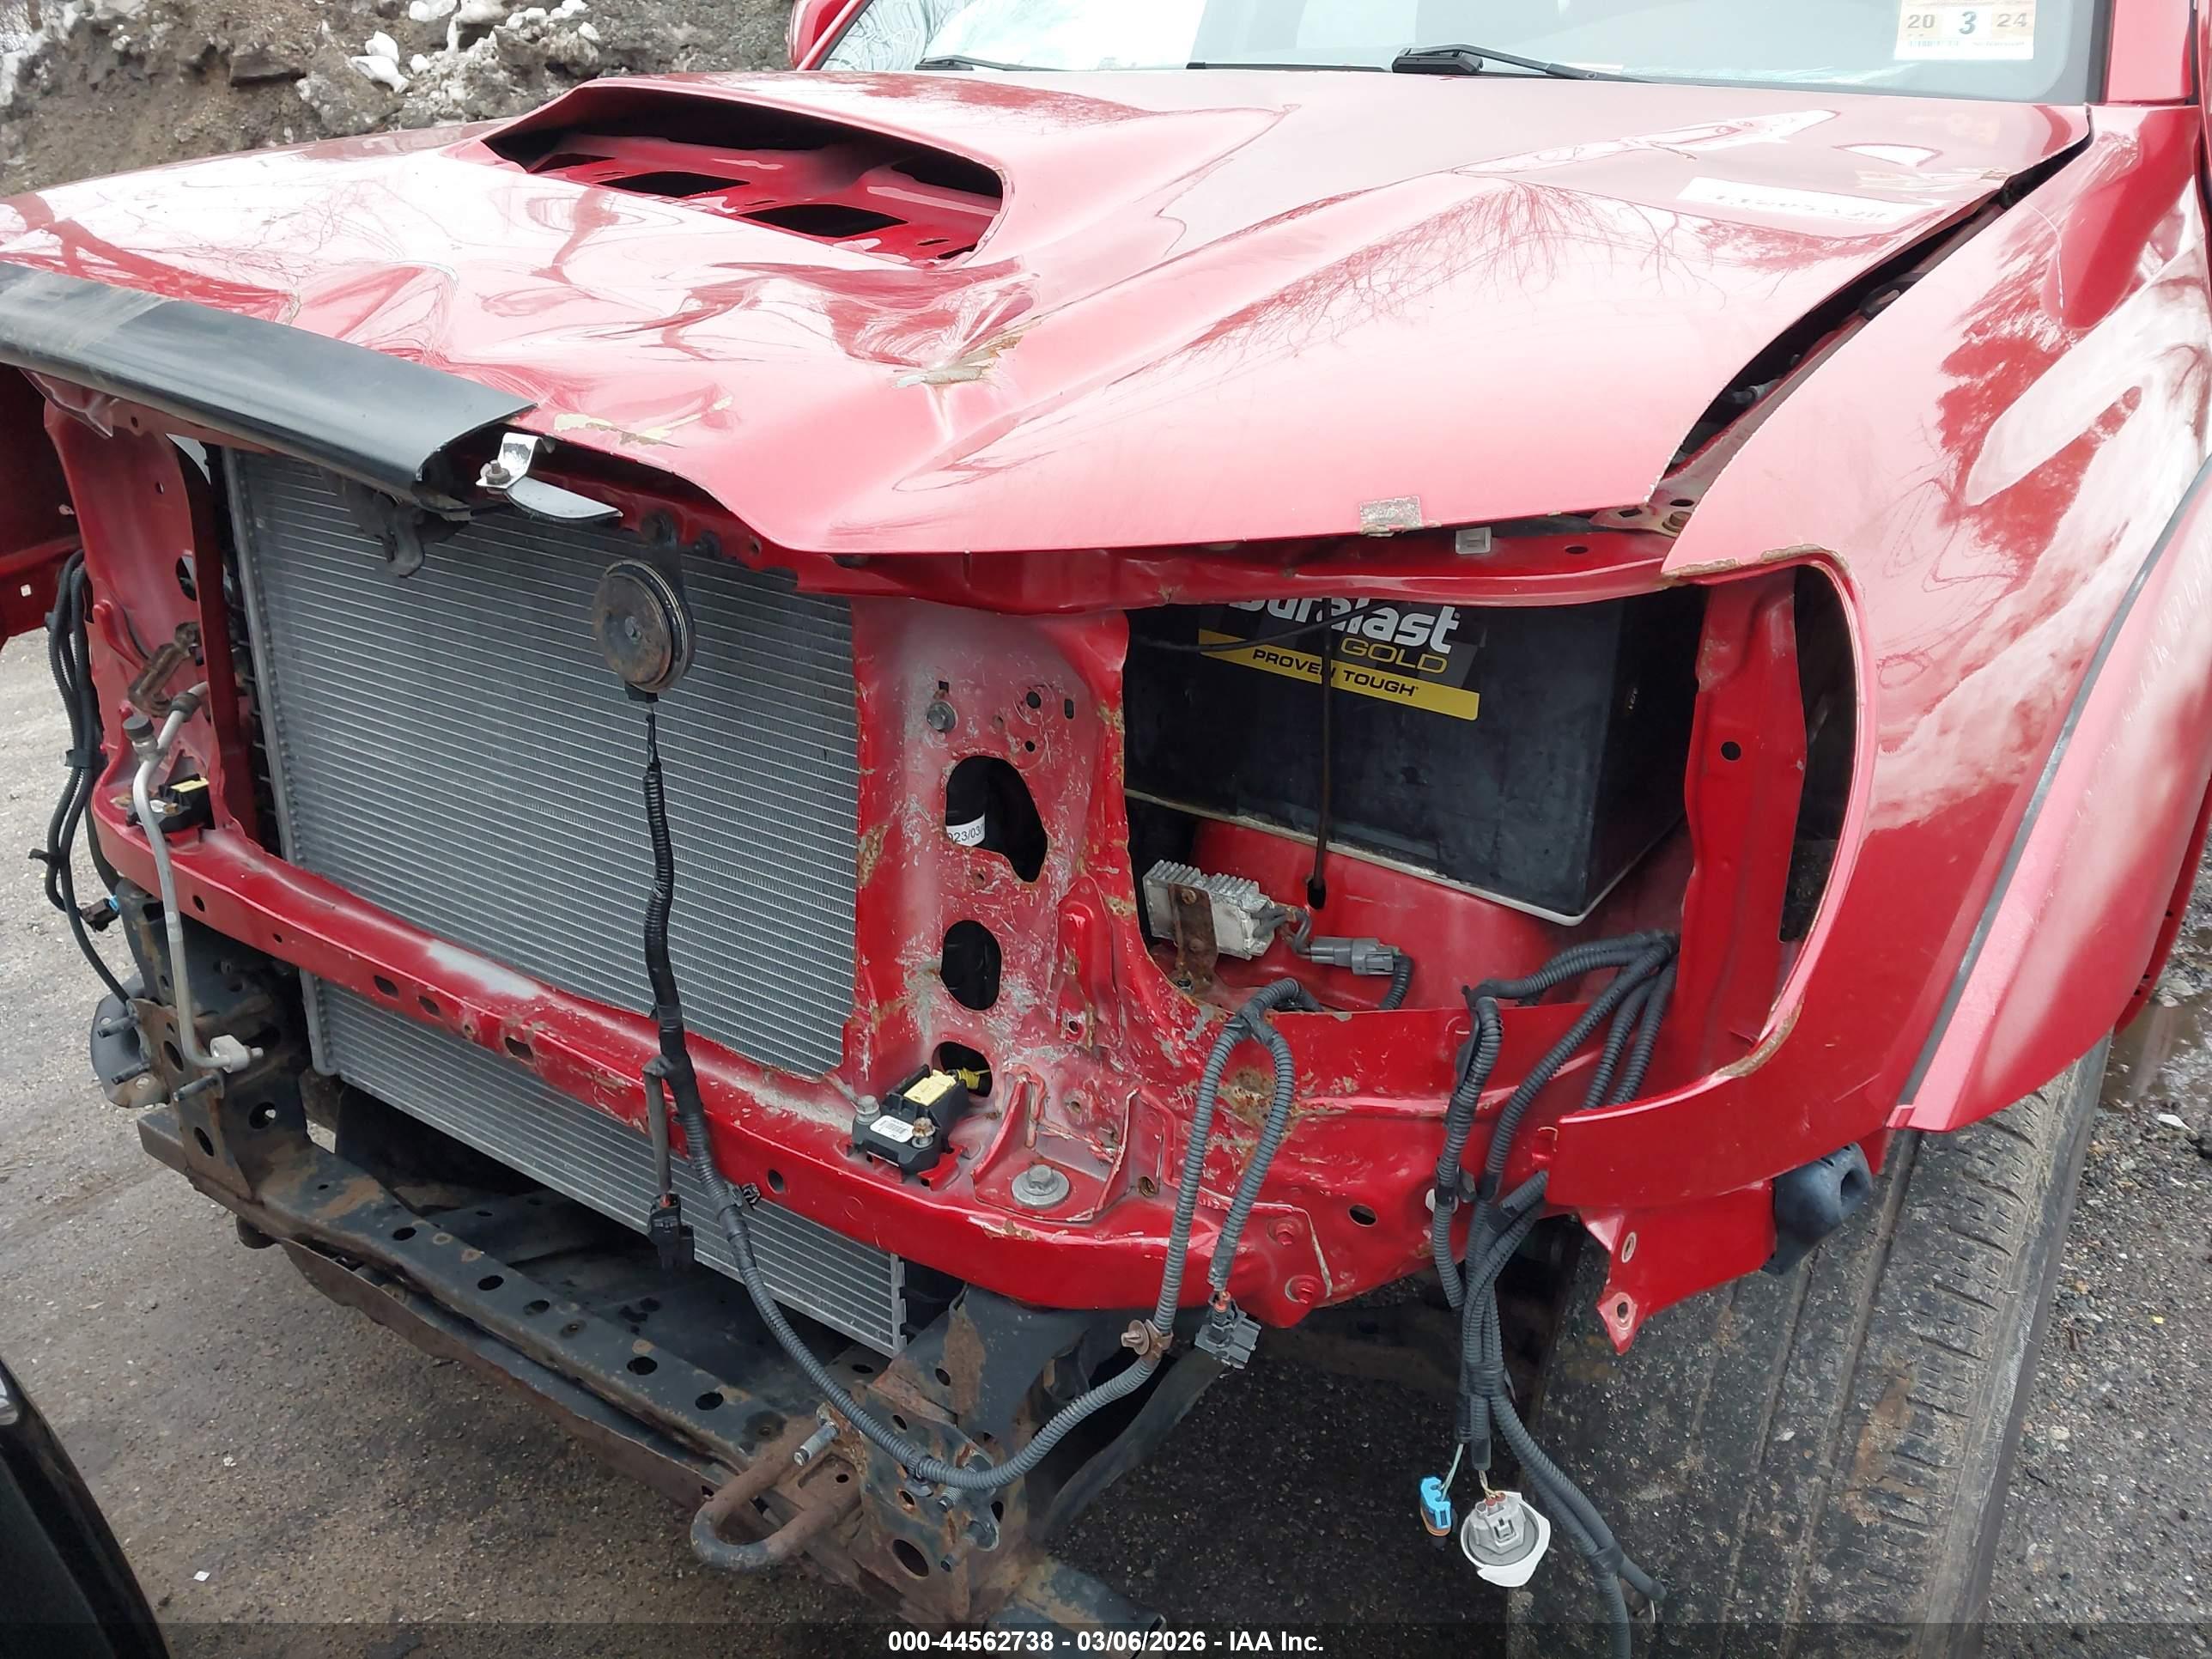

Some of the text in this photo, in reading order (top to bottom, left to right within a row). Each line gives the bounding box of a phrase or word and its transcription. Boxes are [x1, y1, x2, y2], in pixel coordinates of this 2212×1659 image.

[1907, 10, 2027, 34] 20 3 24
[1340, 637, 1449, 674] GOLD
[1343, 670, 1416, 697] TOUGH
